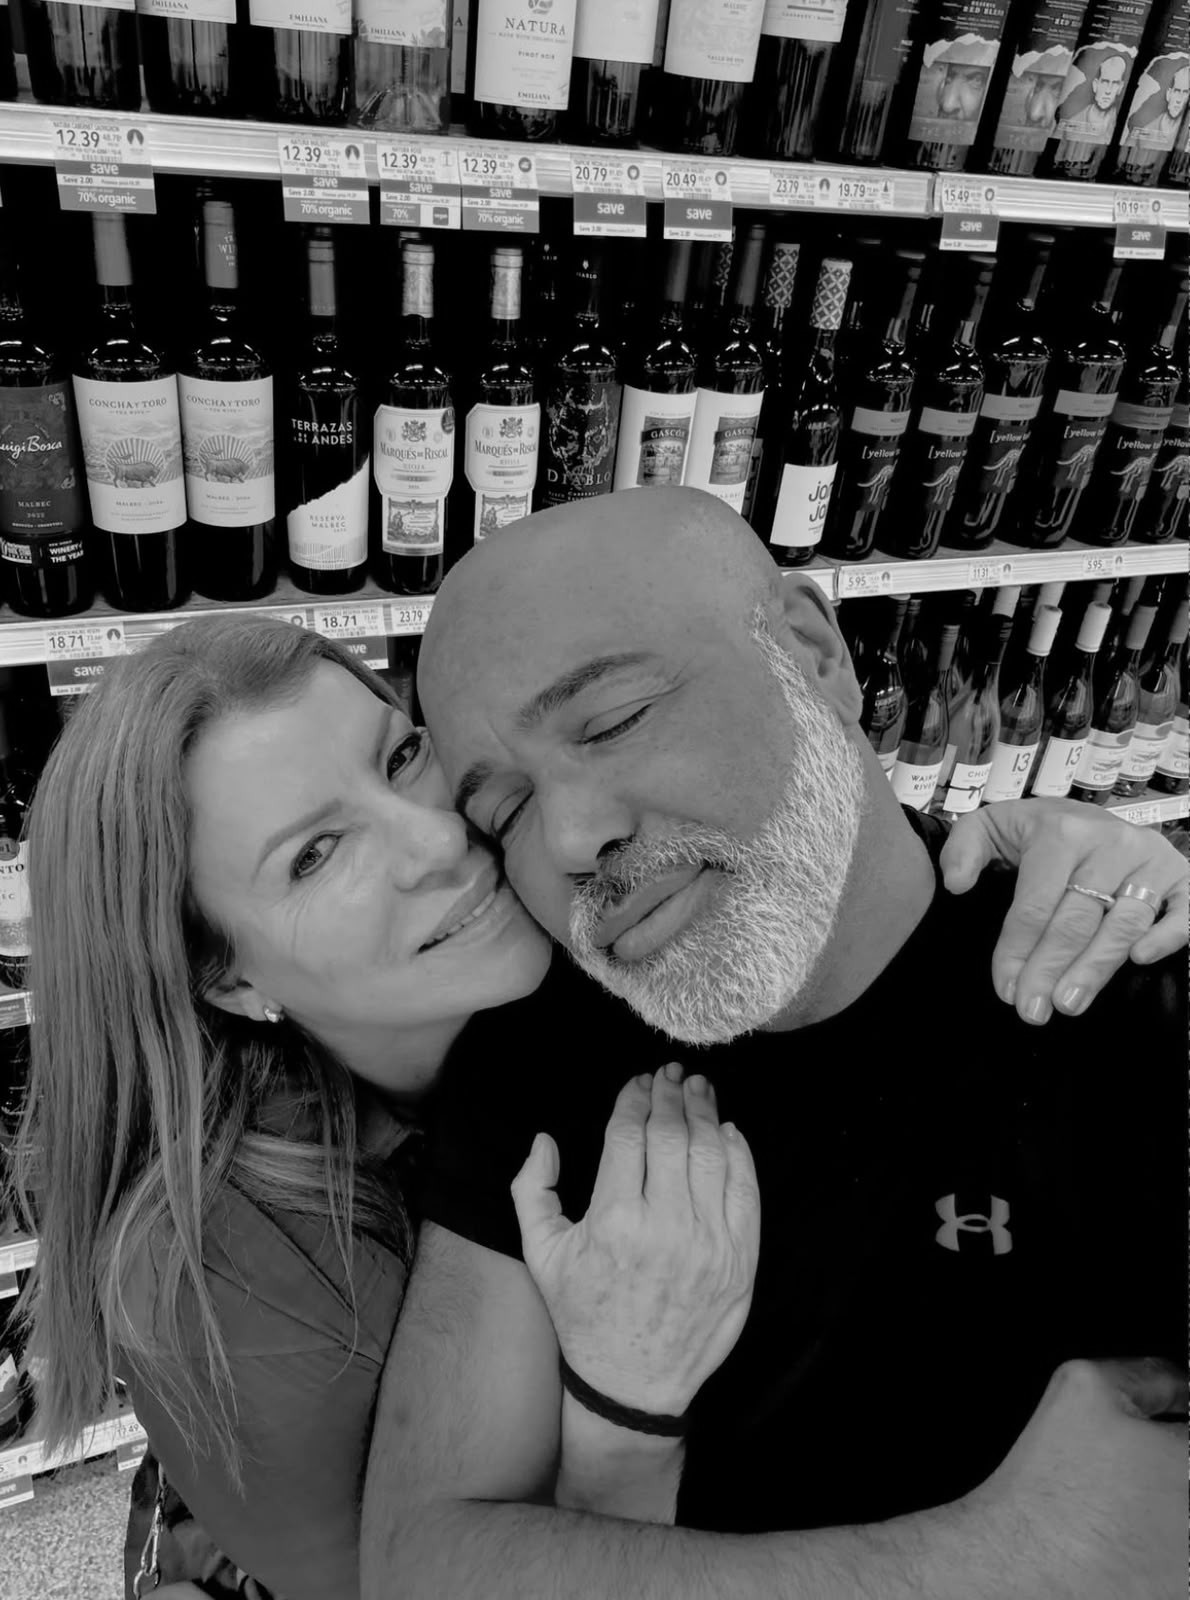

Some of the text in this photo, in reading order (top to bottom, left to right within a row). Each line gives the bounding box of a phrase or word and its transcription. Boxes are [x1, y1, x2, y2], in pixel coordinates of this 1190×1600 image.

[289, 14, 329, 24] EMILIANA
[370, 27, 406, 38] EMILIANA
[504, 17, 566, 36] NATURA
[56, 129, 100, 148] 12.39
[283, 145, 322, 163] 12.39
[381, 152, 418, 169] 12.39
[89, 163, 119, 175] save
[463, 158, 497, 174] 12.39
[575, 165, 607, 181] 20.79
[666, 172, 697, 187] 20.49
[312, 176, 338, 188] save
[409, 182, 433, 193] save
[489, 188, 512, 199] save
[839, 183, 866, 197] 19.79
[77, 191, 136, 207] 70% organic
[300, 203, 353, 218] 70% organic
[392, 208, 409, 219] 70%
[596, 202, 625, 215] save
[686, 207, 713, 220] save
[493, 212, 524, 227] organic
[960, 221, 982, 232] save
[1131, 231, 1151, 241] save
[88, 397, 131, 409] CONCHA
[141, 397, 167, 408] TORO
[186, 395, 226, 408] CONCHA
[234, 397, 261, 408] TORO
[291, 418, 353, 432] TERRAZAS
[26, 435, 62, 452] Bosca
[311, 433, 353, 445] ANDES
[547, 468, 612, 486] DIABLO
[17, 500, 51, 508] MALBEC
[49, 543, 79, 555] WINERY
[50, 555, 67, 564] THE
[322, 615, 357, 628] 18.71
[400, 610, 422, 623] 23.79
[49, 635, 84, 648] 18.71
[73, 664, 104, 677] save
[1012, 752, 1031, 773] 13
[1066, 746, 1083, 767] 13
